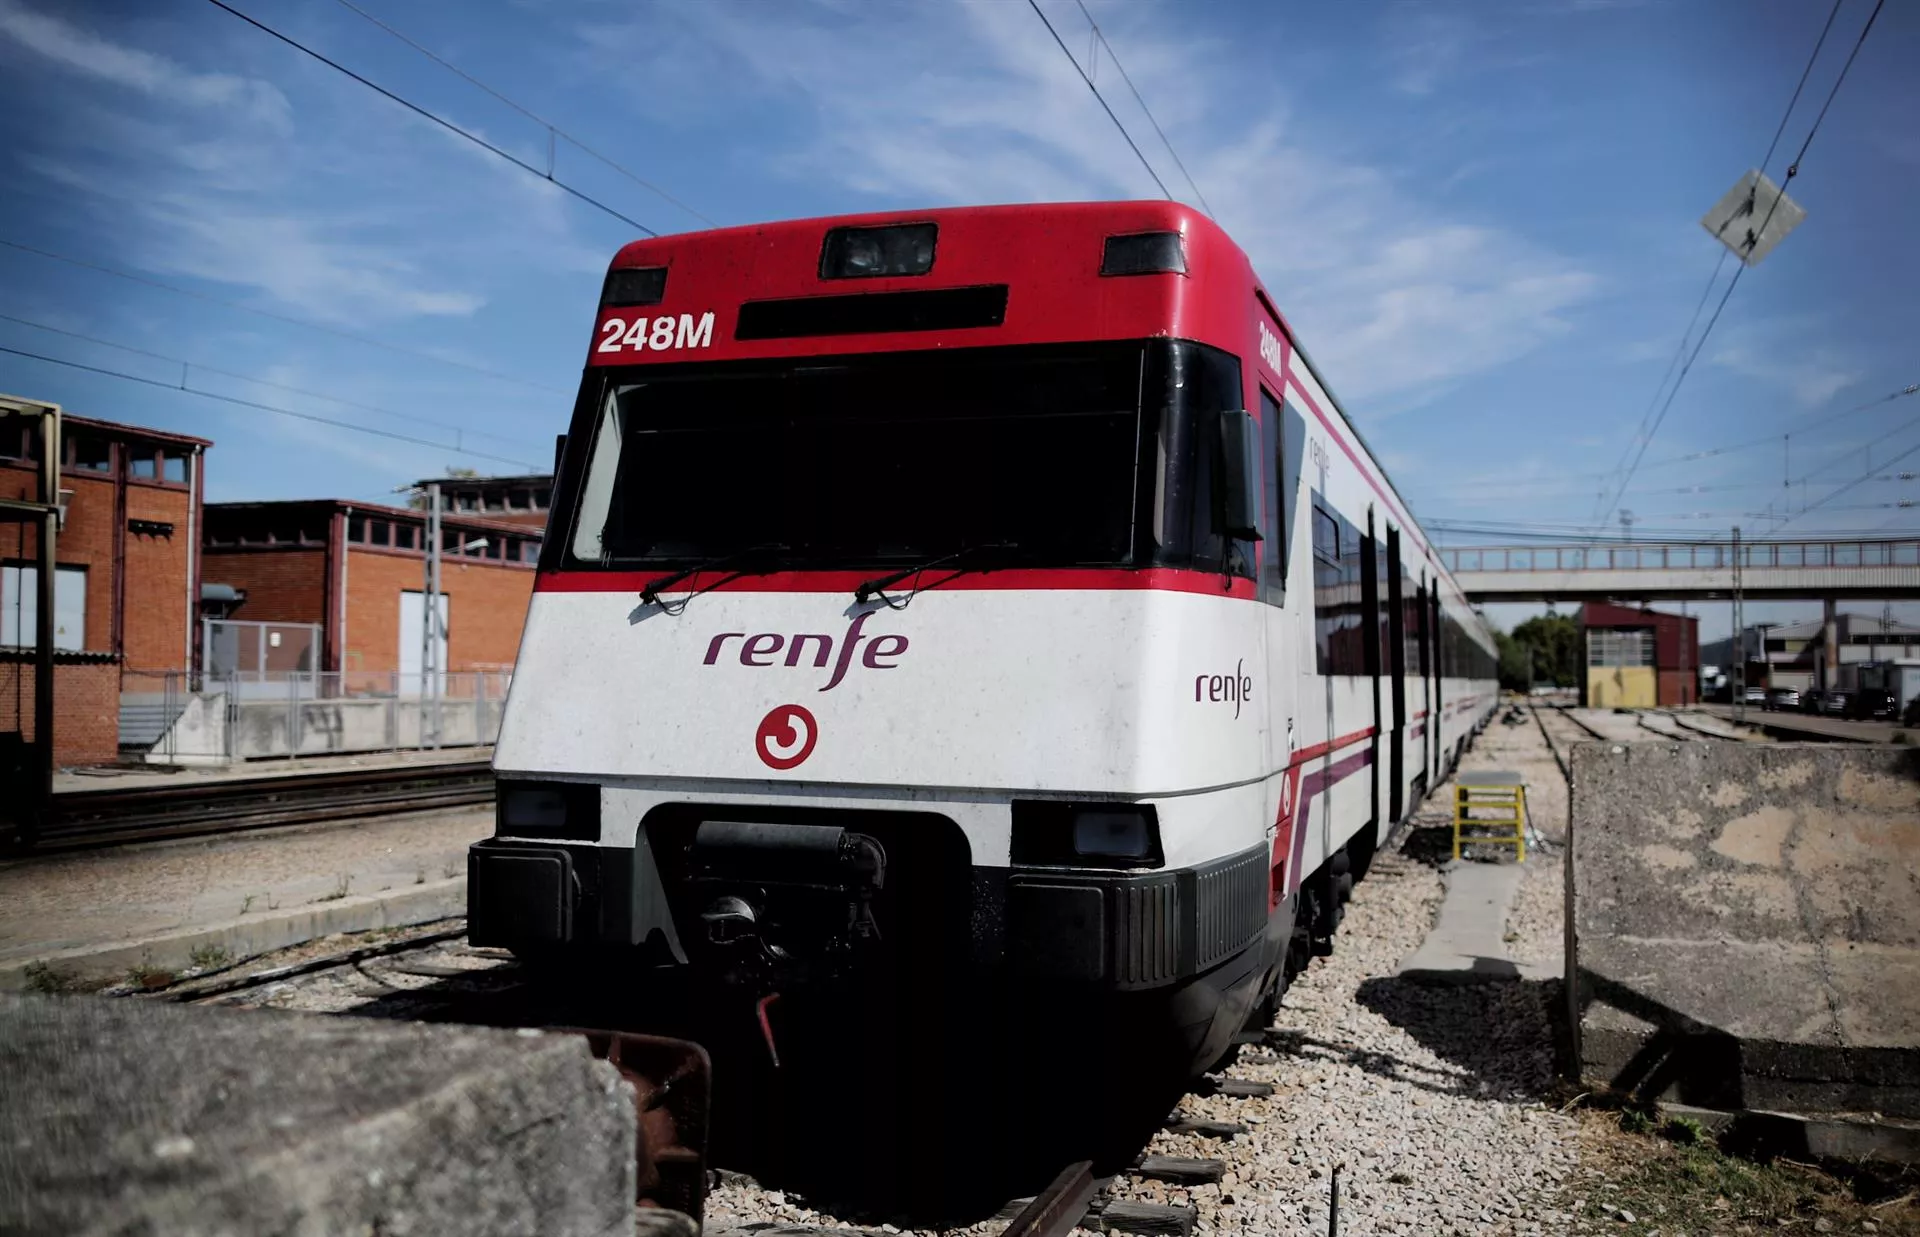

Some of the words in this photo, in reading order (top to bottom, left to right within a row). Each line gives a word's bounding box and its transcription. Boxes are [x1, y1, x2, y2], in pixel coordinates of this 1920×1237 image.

[598, 312, 715, 352] 248M
[703, 610, 909, 692] renfe
[1195, 658, 1251, 720] renfe
